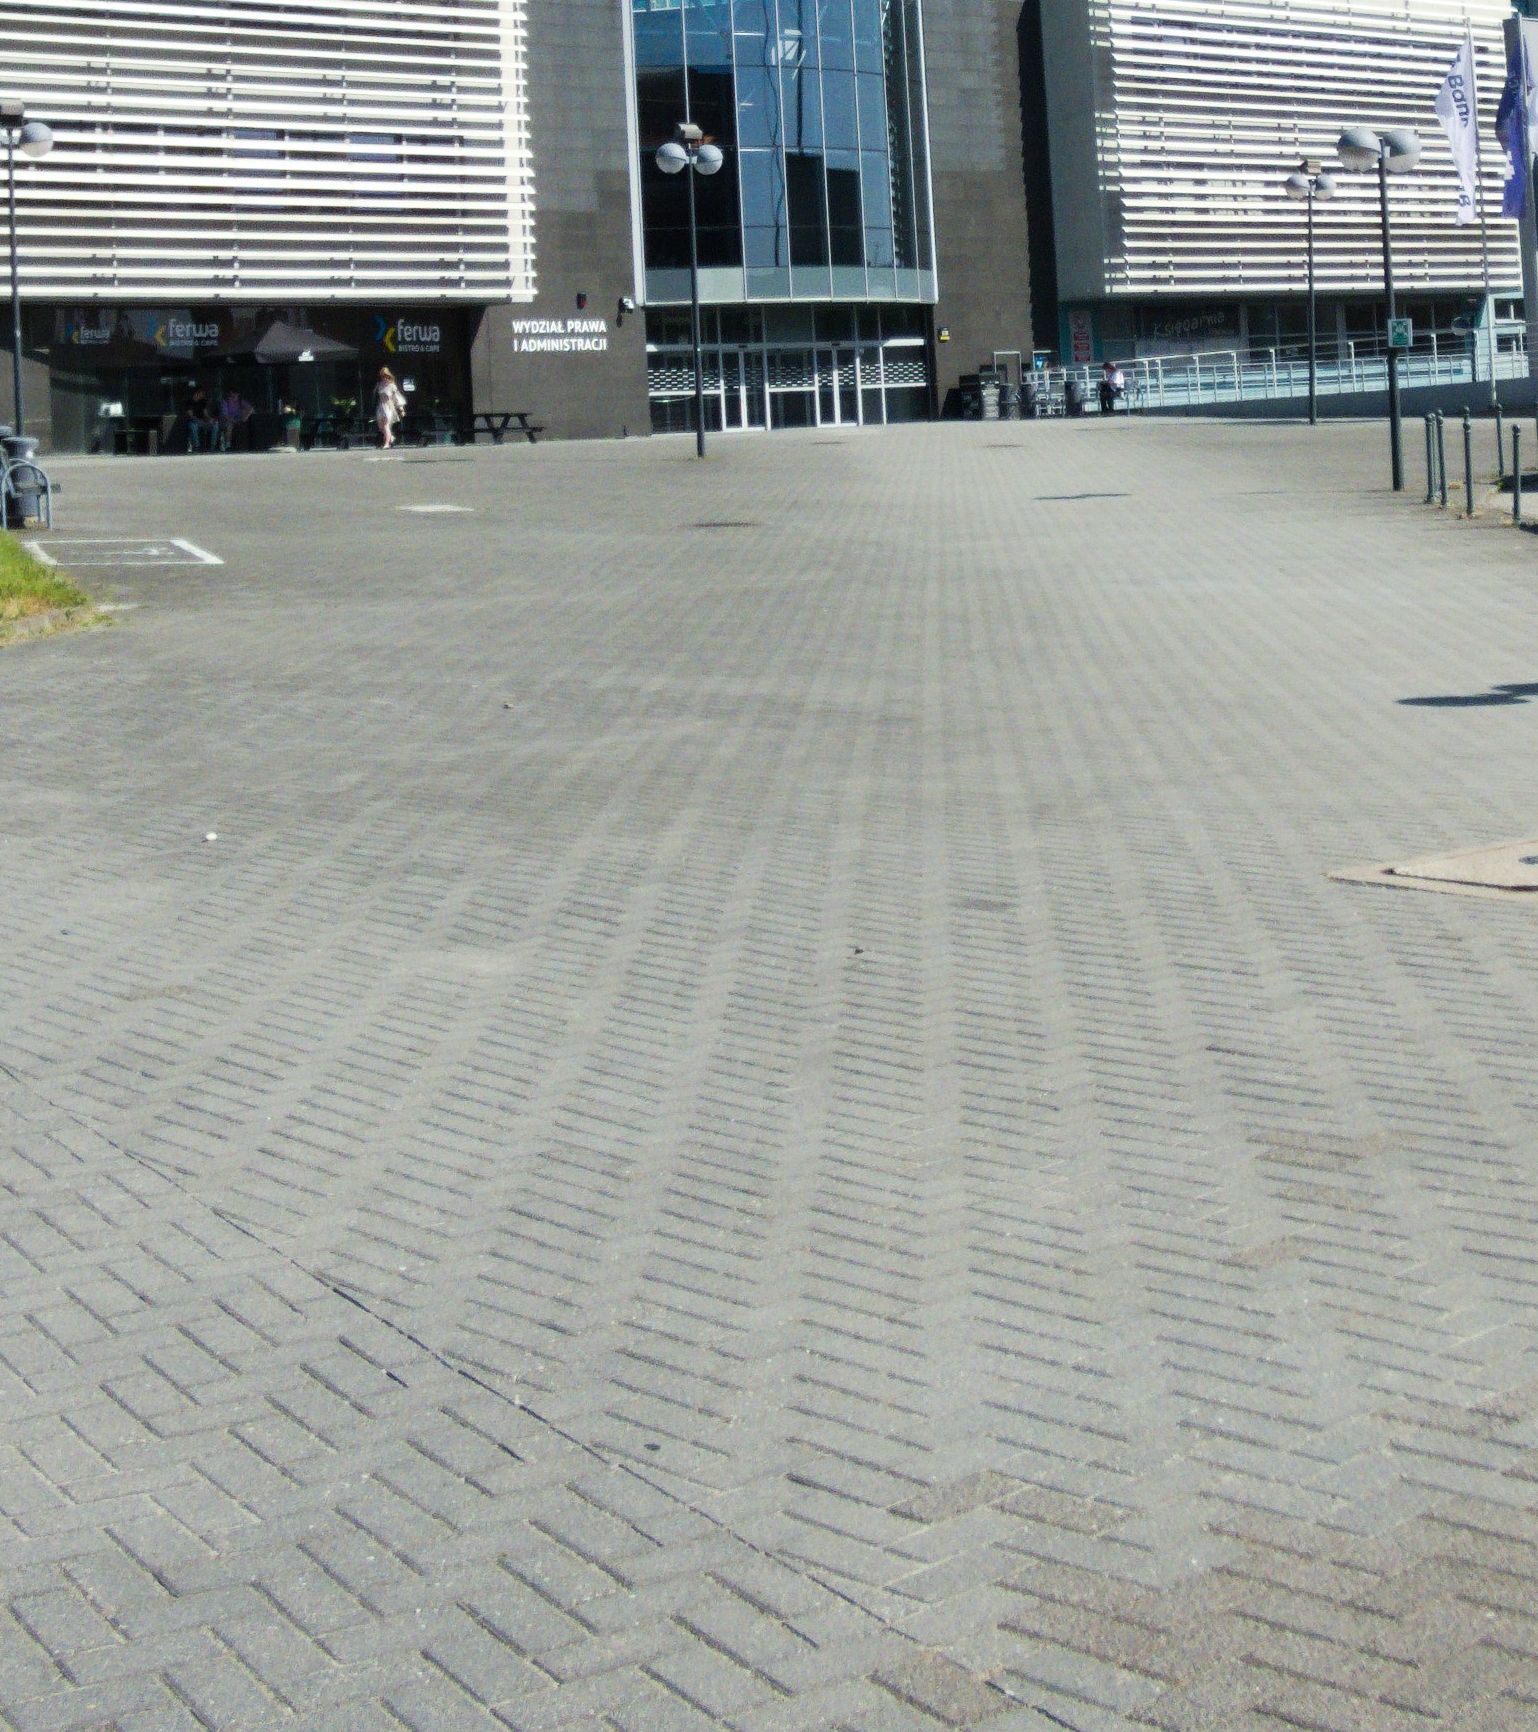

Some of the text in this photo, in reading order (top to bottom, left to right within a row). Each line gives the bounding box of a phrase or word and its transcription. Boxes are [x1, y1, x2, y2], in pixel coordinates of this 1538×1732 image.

[168, 318, 219, 338] ferwa
[397, 318, 441, 342] ferwa
[512, 319, 607, 333] WYDZIAŁ PRAWA
[513, 338, 607, 352] I ADMINISTRACJI
